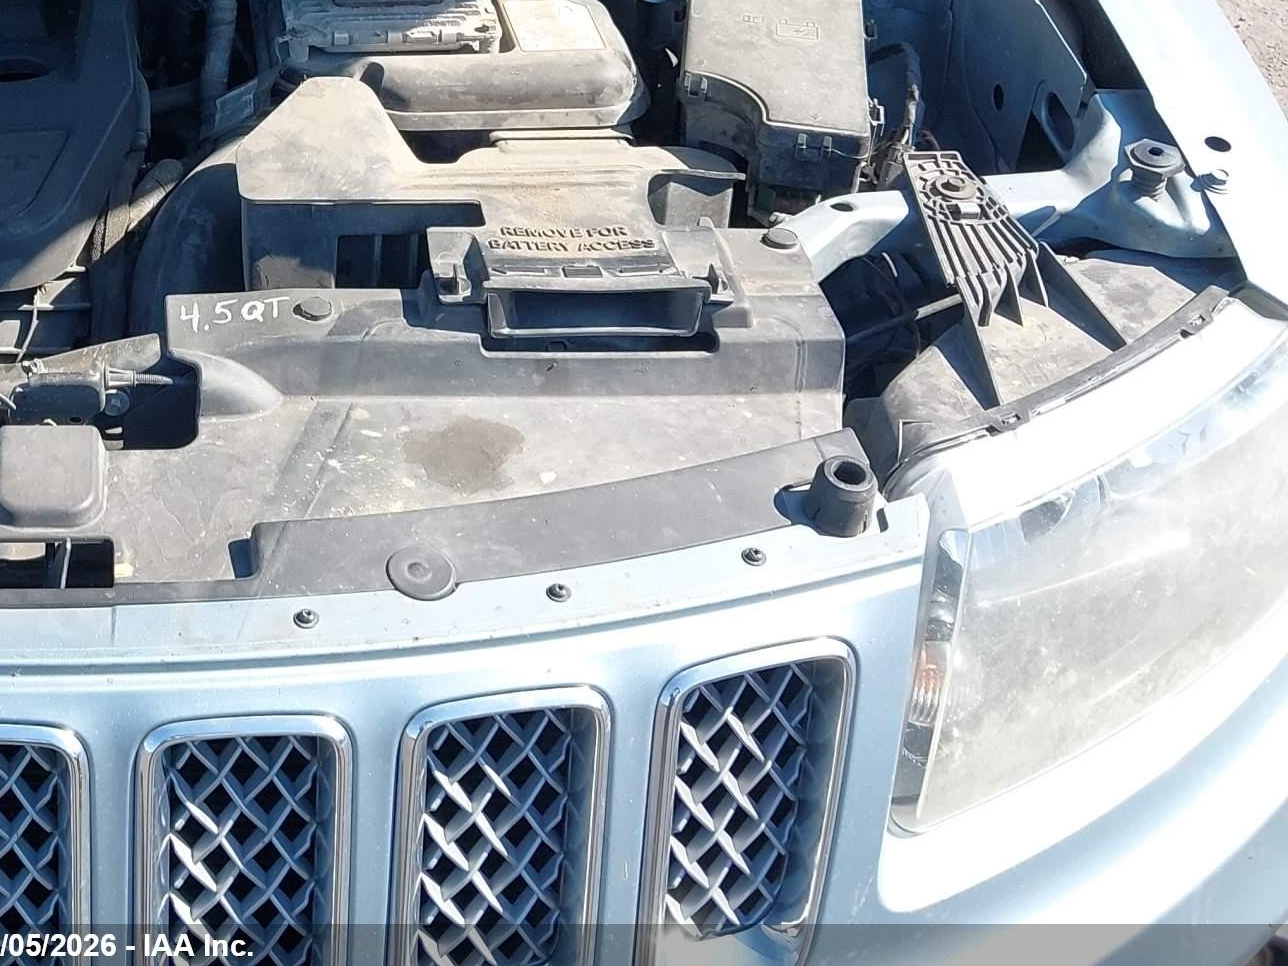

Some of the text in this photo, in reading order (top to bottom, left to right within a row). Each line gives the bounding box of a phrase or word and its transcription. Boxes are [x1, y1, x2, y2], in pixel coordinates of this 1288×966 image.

[500, 225, 629, 239] REMOVE FOR
[487, 238, 657, 252] BATTERY ACCESS
